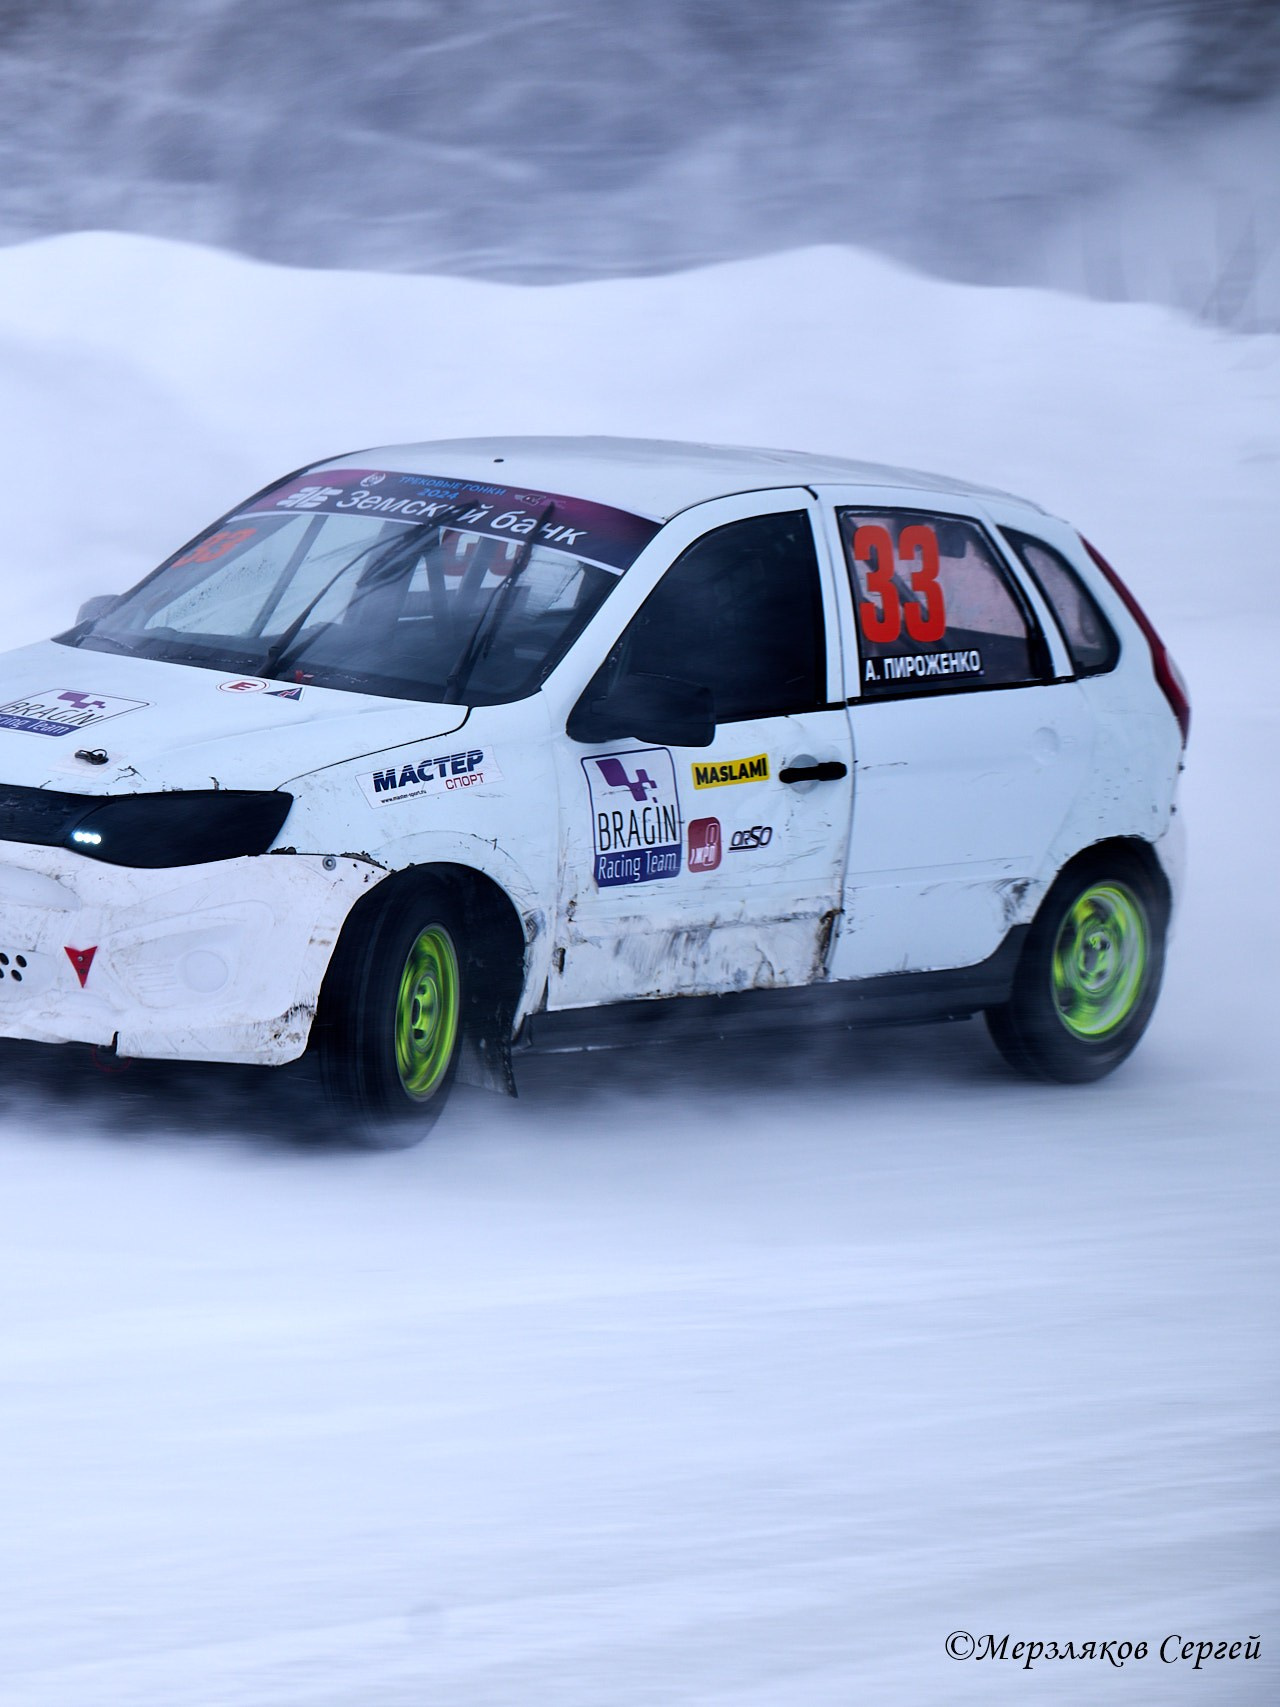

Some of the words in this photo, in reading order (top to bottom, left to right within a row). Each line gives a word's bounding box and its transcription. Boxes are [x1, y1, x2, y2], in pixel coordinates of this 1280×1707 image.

[401, 476, 462, 490] ТРЕКОВЫЕ
[462, 483, 507, 496] ГОНКИ
[417, 487, 459, 500] 2024
[490, 510, 589, 546] банк
[853, 525, 946, 643] 33
[865, 659, 881, 682] А.
[884, 650, 982, 680] ПИРОЖЕНКО
[28, 720, 71, 735] Team
[373, 749, 484, 793] МАСТЕР
[445, 772, 484, 790] СПОРТ
[695, 757, 768, 786] MASLAMI
[598, 854, 641, 881] Racing
[645, 850, 677, 875] Team
